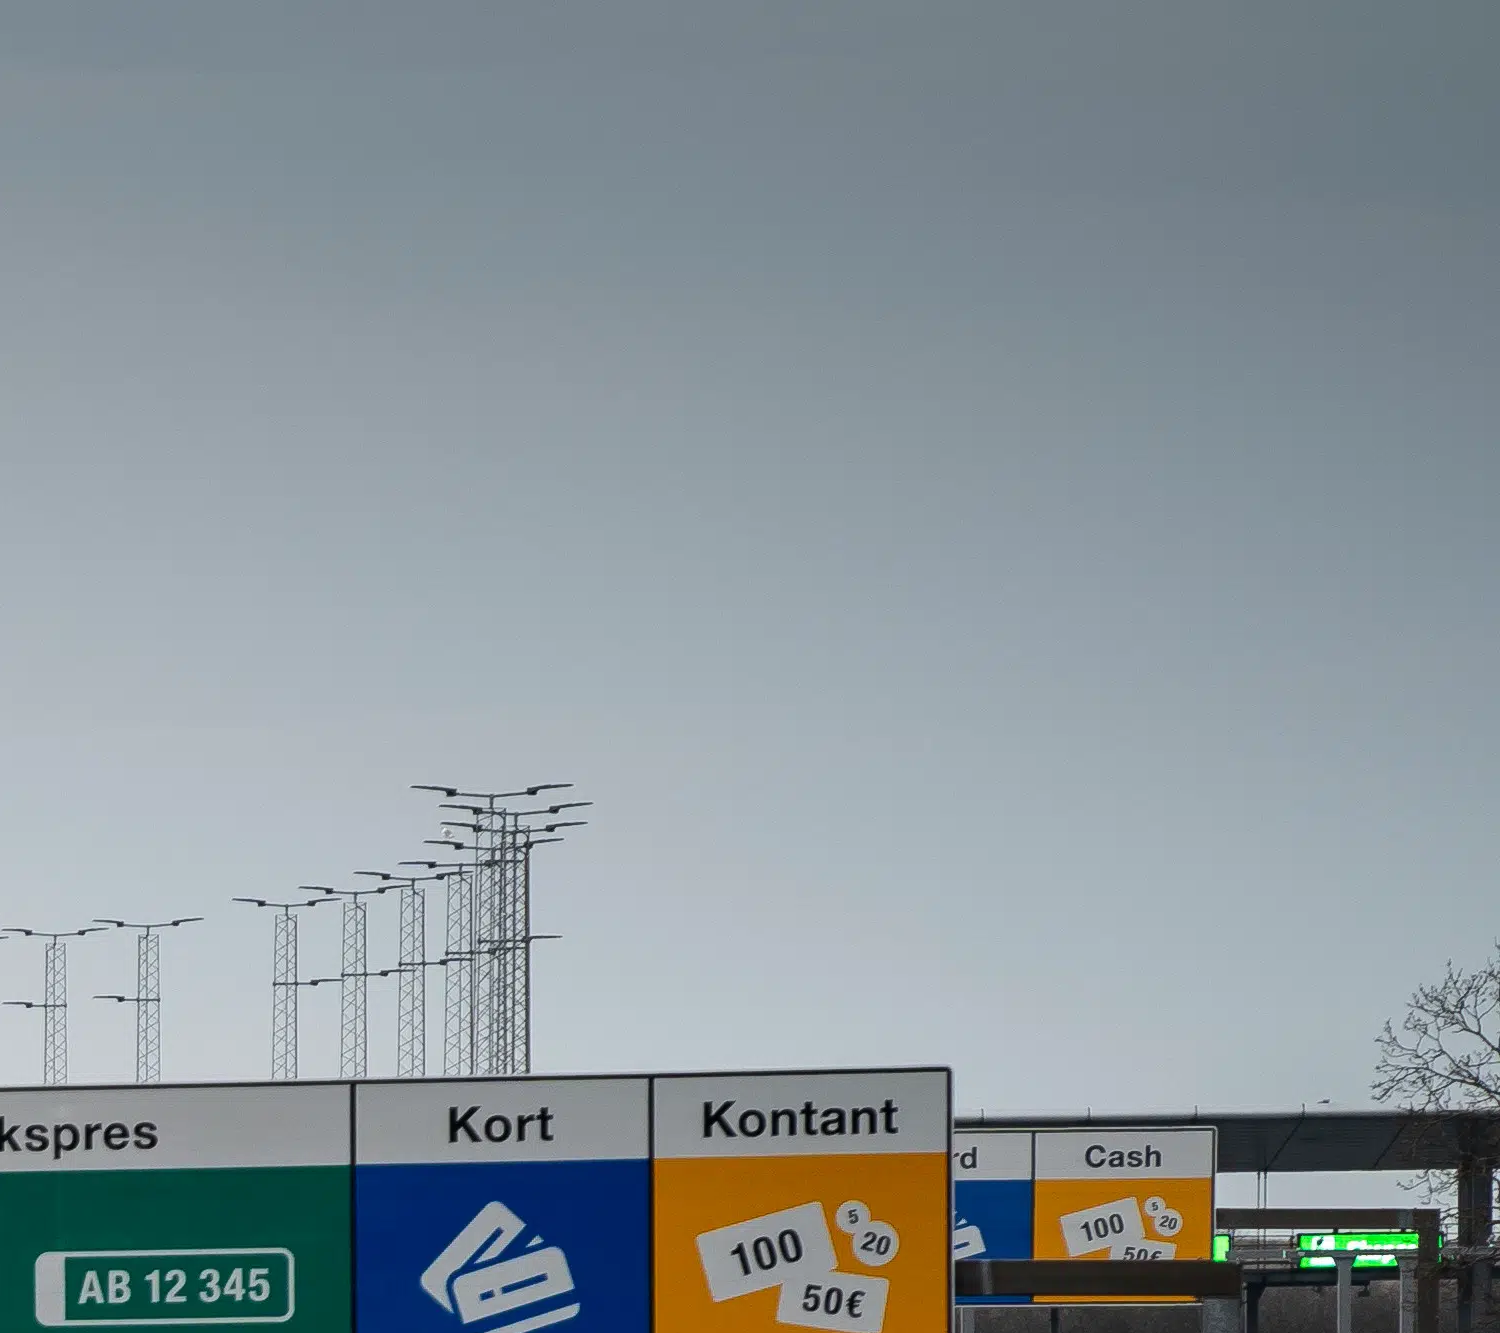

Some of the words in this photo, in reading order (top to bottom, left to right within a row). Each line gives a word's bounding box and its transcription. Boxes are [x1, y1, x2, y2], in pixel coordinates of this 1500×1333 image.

[448, 1105, 554, 1143] Kort
[702, 1099, 899, 1138] Kontant
[1084, 1145, 1162, 1169] Cash
[847, 1209, 859, 1224] 5
[1079, 1214, 1125, 1241] 100
[1158, 1216, 1178, 1230] 20
[730, 1228, 804, 1277] 100
[860, 1231, 891, 1256] 20
[77, 1270, 132, 1305] AB
[144, 1269, 188, 1304] 12
[198, 1267, 271, 1303] 345
[802, 1283, 867, 1319] 50€
